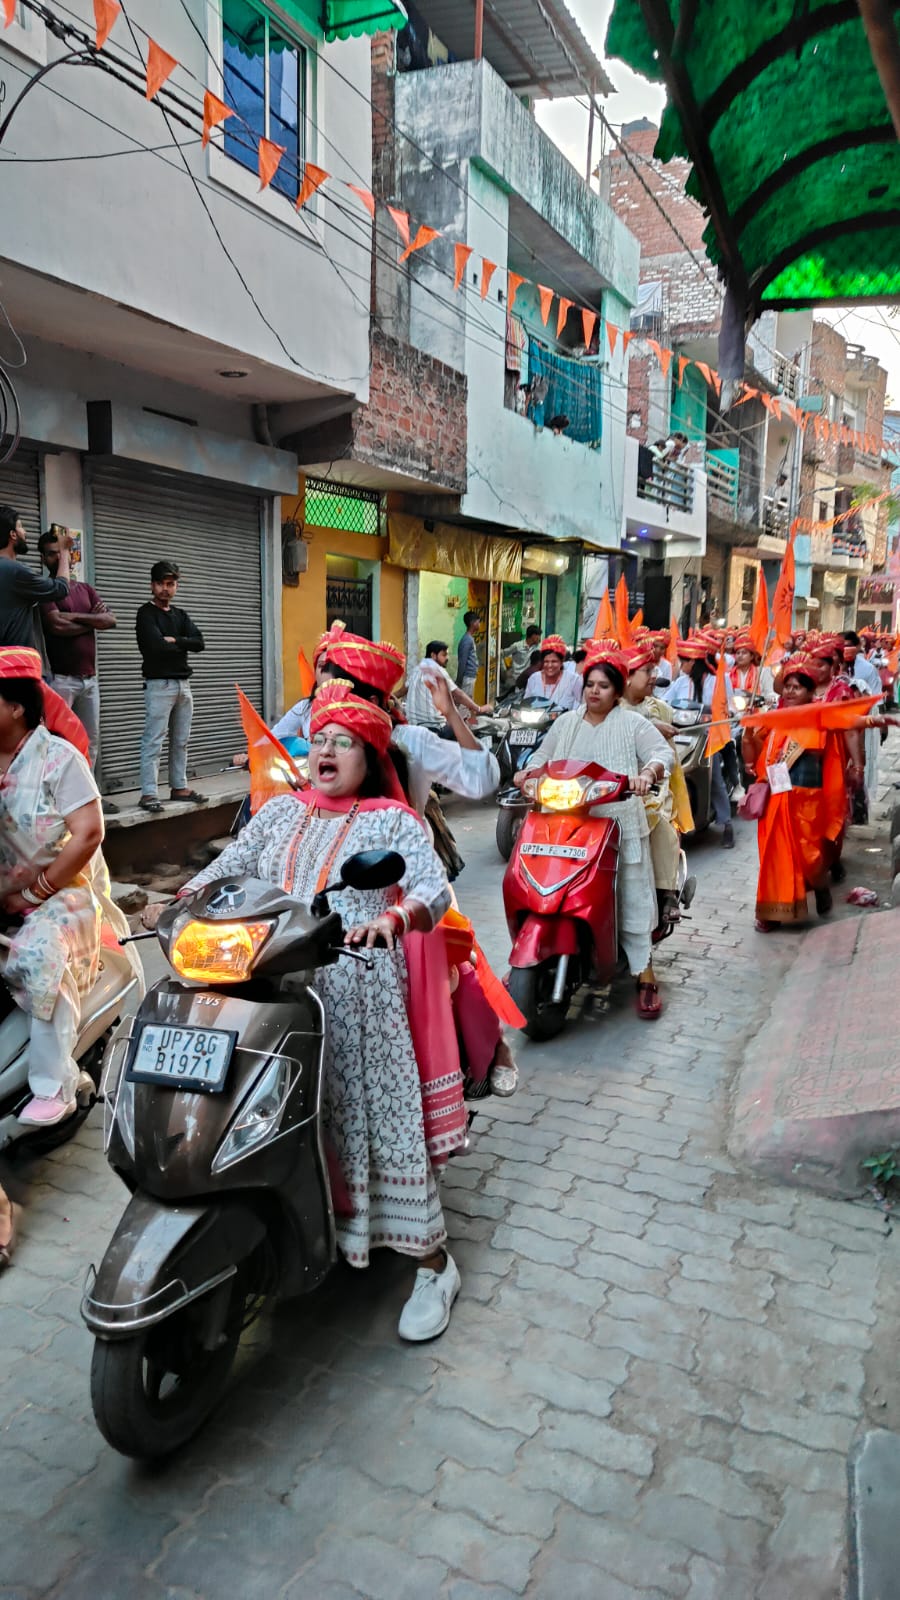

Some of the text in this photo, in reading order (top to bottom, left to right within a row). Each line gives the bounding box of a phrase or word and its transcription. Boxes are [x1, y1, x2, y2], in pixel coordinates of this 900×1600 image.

[568, 848, 586, 857] 7306
[196, 995, 222, 1006] TVS
[160, 1029, 219, 1054] UP78G
[155, 1052, 212, 1078] B1971
